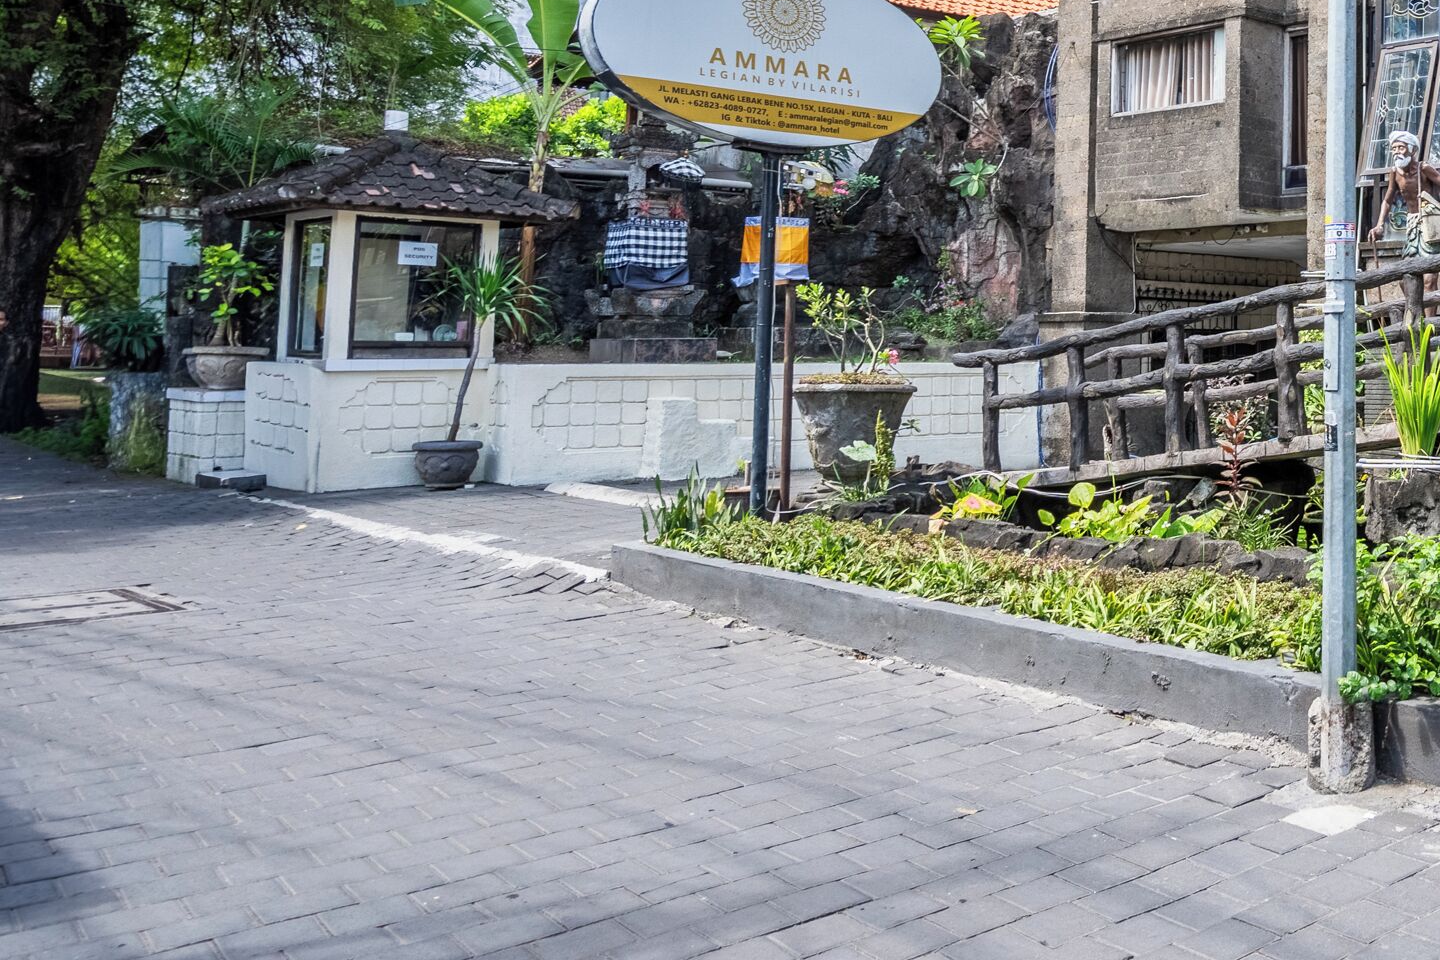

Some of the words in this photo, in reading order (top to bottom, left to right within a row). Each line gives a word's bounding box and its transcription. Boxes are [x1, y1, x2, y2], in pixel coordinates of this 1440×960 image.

[699, 67, 761, 83] LEGIAN
[768, 77, 786, 87] BY
[792, 81, 860, 97] VILARISI
[709, 47, 852, 84] AMMARA
[658, 85, 669, 93] JL.
[672, 87, 708, 97] MELASTI
[710, 92, 735, 101] GANG
[737, 96, 762, 105] LEBAK
[764, 100, 784, 108] BENE
[818, 106, 845, 115] LEGIAN
[851, 111, 871, 119] KUTA
[877, 114, 893, 122] BALI
[663, 95, 680, 105] WA
[789, 113, 888, 130] ammaralegian@gmail.com
[735, 115, 743, 123] &
[745, 116, 771, 127] Tiktok
[777, 121, 840, 134] @ammara_hotel
